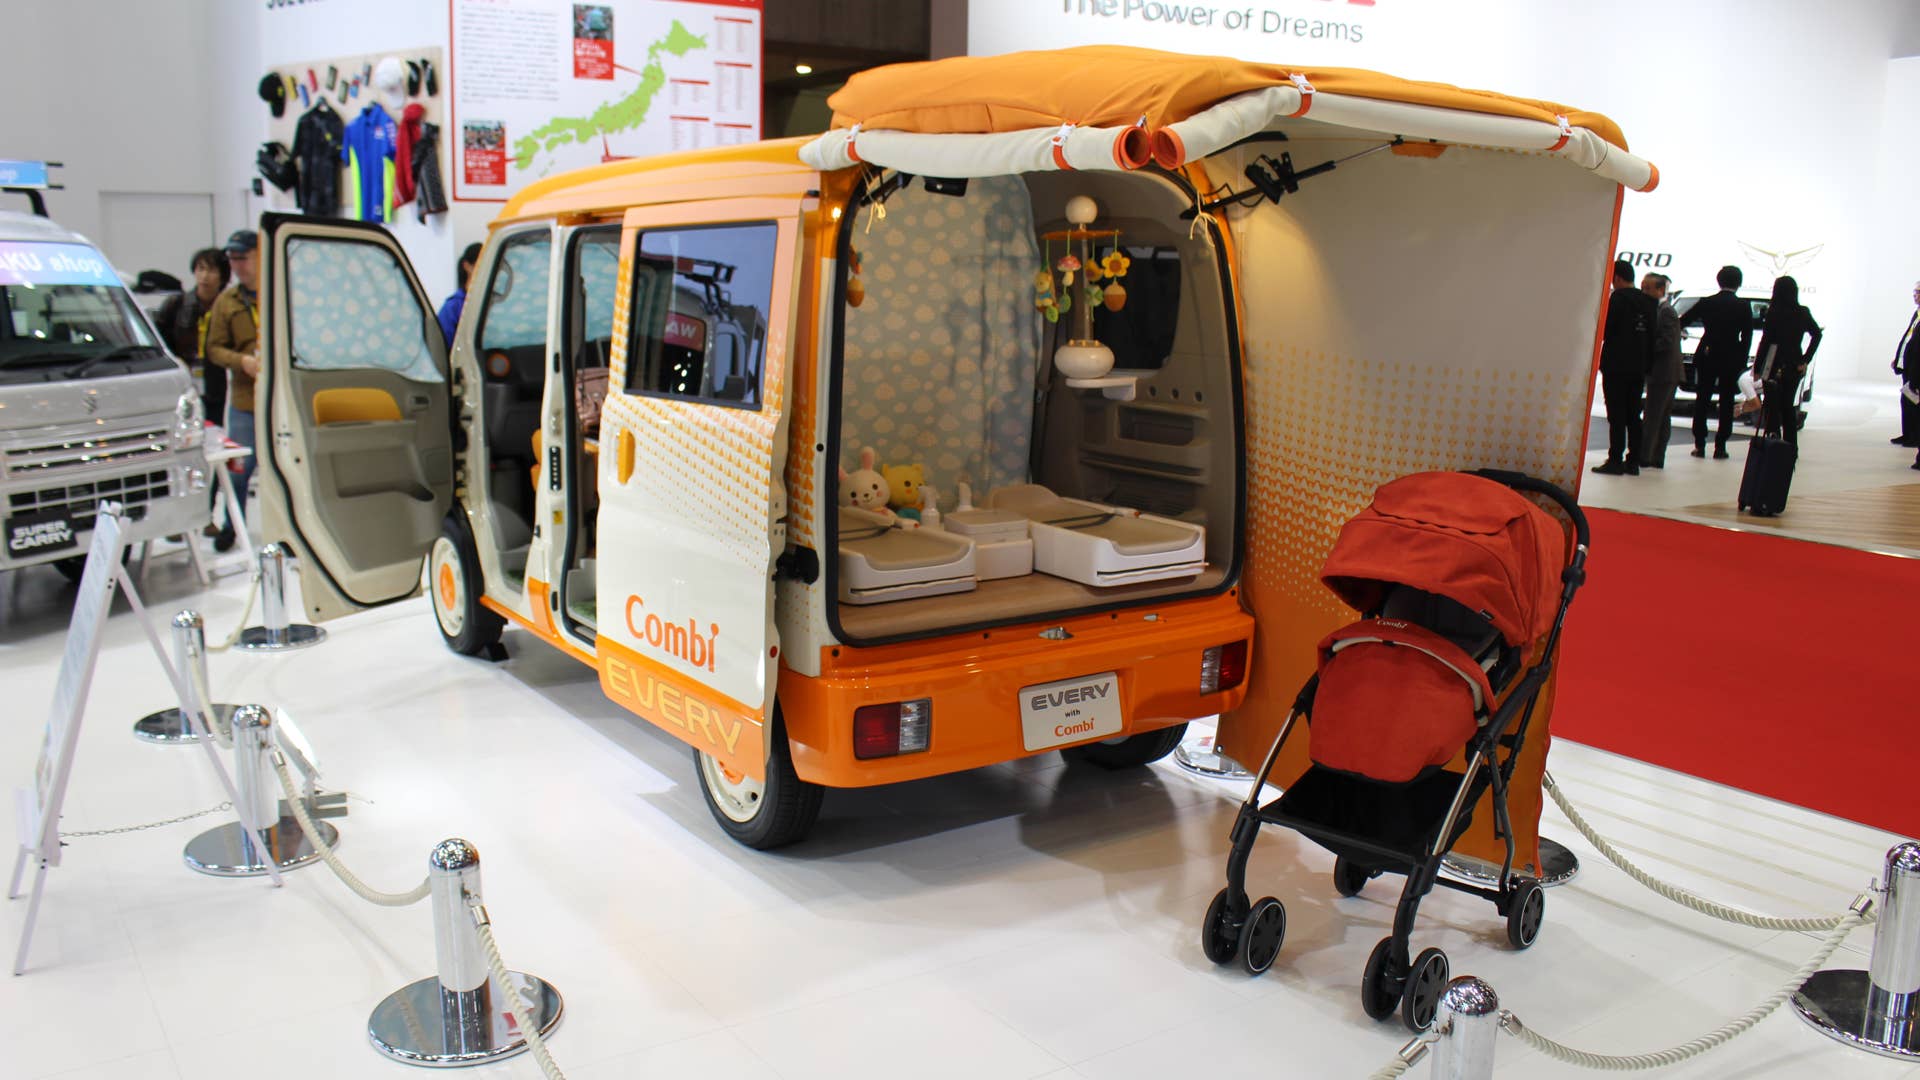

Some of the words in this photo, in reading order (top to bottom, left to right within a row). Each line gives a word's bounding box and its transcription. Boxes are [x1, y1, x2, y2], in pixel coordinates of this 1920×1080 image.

[1123, 0, 1218, 27] Power
[1223, 9, 1253, 30] of
[1262, 10, 1363, 43] Dreams
[49, 252, 104, 279] shop
[10, 529, 73, 551] CARRY
[13, 520, 66, 539] SUPER
[625, 594, 720, 674] Combi
[1376, 619, 1408, 629] Combi
[605, 656, 743, 755] EVERY
[1031, 682, 1110, 711] EVERY
[1065, 709, 1081, 718] with
[1054, 717, 1095, 737] Combi
